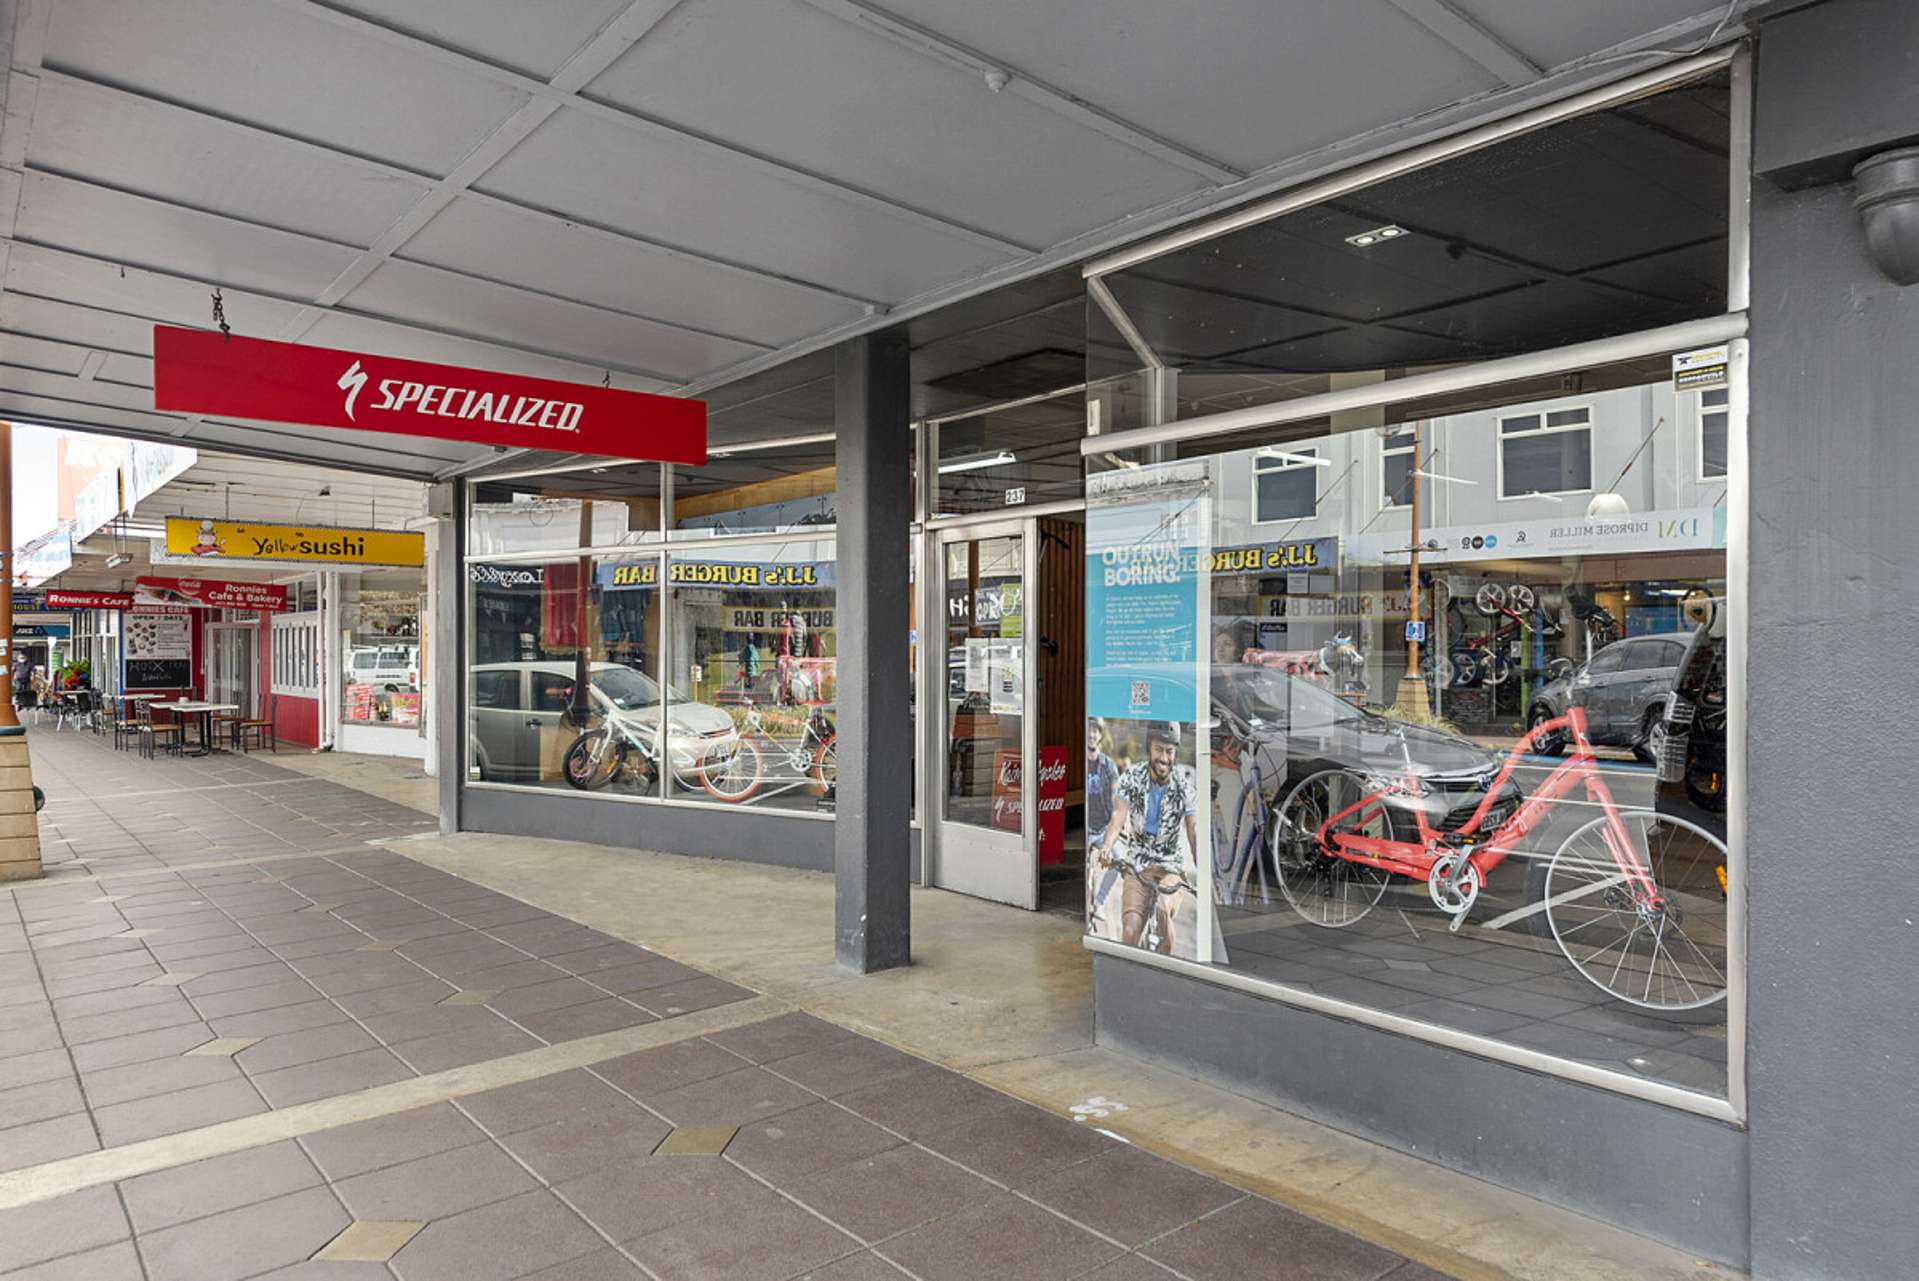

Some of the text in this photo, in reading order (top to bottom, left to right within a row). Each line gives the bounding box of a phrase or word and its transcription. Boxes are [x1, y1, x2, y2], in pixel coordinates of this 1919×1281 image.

[370, 379, 584, 432] SPECIALIZED
[1006, 489, 1025, 503] 237
[299, 537, 365, 556] sushi
[1103, 543, 1180, 565] OUTRUN
[1104, 564, 1181, 586] BORING.
[224, 583, 268, 594] Ronnies
[102, 597, 130, 605] CAFE
[208, 591, 233, 600] Cafe
[236, 593, 244, 601] &
[246, 594, 282, 605] Bakery
